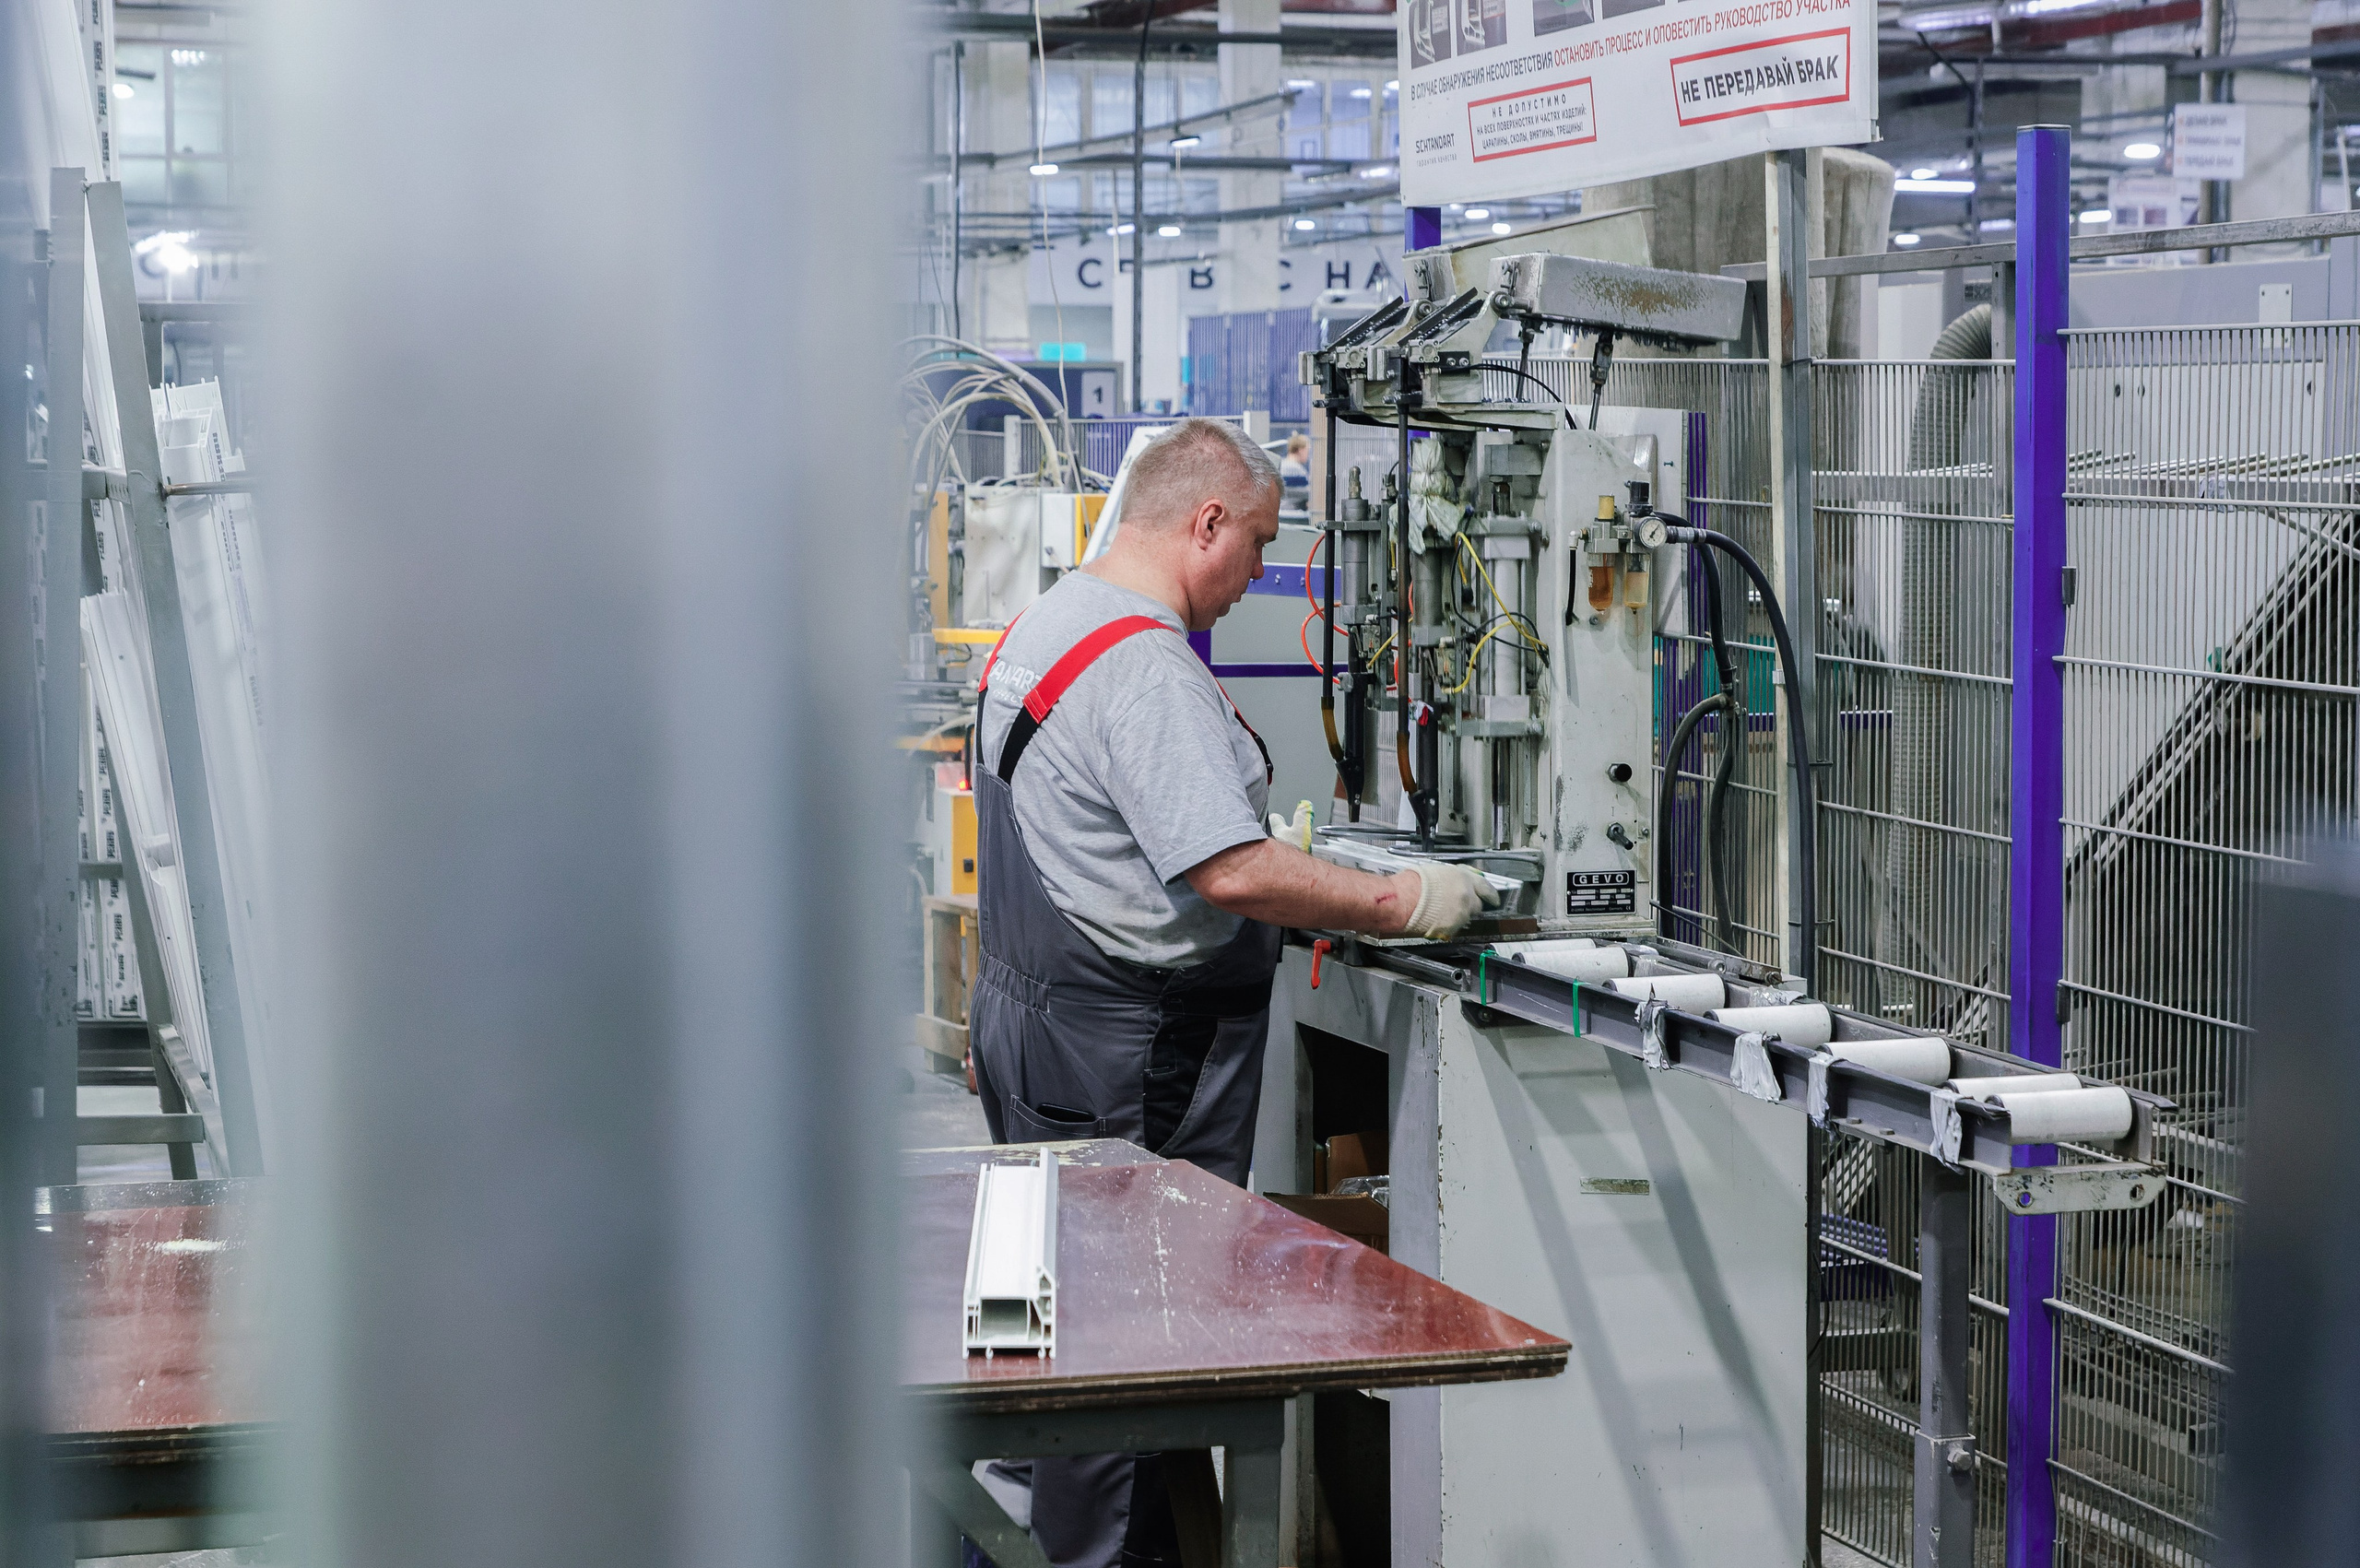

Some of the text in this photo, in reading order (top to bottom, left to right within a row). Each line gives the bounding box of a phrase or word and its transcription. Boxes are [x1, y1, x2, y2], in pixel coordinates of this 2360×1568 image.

[1411, 85, 1415, 100] В
[1416, 78, 1437, 100] СЛУЧАЕ
[1439, 67, 1485, 93] ОБНАРУЖЕНИЯ
[1486, 52, 1553, 82] НЕСООТВЕТСТВИЯ
[1554, 40, 1604, 66] ОСТАНОВИТЬ
[1605, 29, 1644, 55] ПРОЦЕСС
[1646, 28, 1652, 46] И
[1653, 15, 1712, 44] ОПОВЕСТИТЬ
[1715, 0, 1792, 31] РУКОВОДСТВО
[1681, 55, 1839, 103] НЕ ПЕРЕДАВАЙ БРАК
[1493, 93, 1567, 118] НЕ ДОПУСТИМО
[1477, 126, 1484, 136] НА
[1484, 124, 1496, 135] ВСЕХ
[1497, 116, 1534, 132] ПОВЕРХНОСТЯХ
[1535, 115, 1540, 124] И
[1540, 111, 1561, 124] ЧАСТЯХ
[1415, 133, 1455, 153] SCHTANDART
[1093, 385, 1103, 404] 1
[1579, 874, 1624, 884] GEVO
